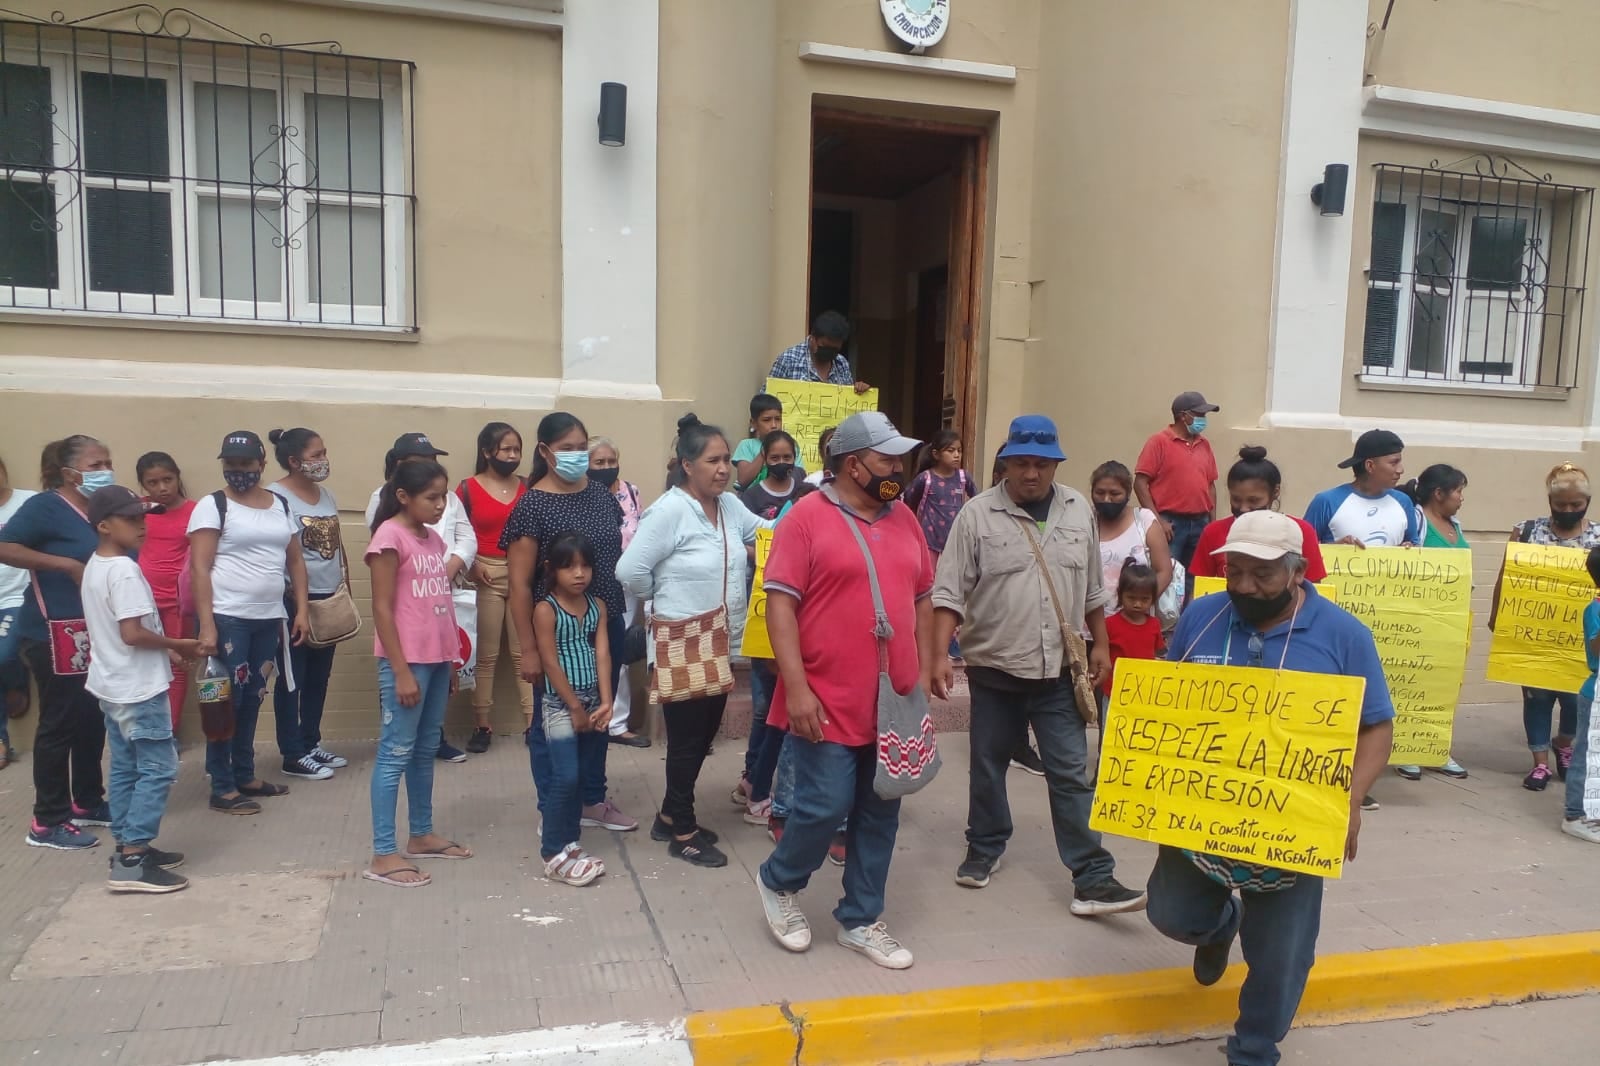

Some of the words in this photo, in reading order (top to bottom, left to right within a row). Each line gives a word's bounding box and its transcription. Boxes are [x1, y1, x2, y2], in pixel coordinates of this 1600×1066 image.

[893, 12, 944, 39] EMBARCACION
[1347, 557, 1461, 585] COMUNIDAD
[1343, 581, 1386, 597] LOMA
[1501, 597, 1558, 620] MISION
[1563, 605, 1578, 623] LA
[1390, 686, 1425, 700] AGUA
[1305, 698, 1347, 727] SE
[1112, 715, 1228, 764] RESPETE
[1236, 731, 1267, 777] LA
[1277, 738, 1353, 794] LIBERTAD
[1104, 757, 1137, 787] DE
[1145, 763, 1291, 814] EXPRESIÓN
[1204, 840, 1257, 856] NACIONAL
